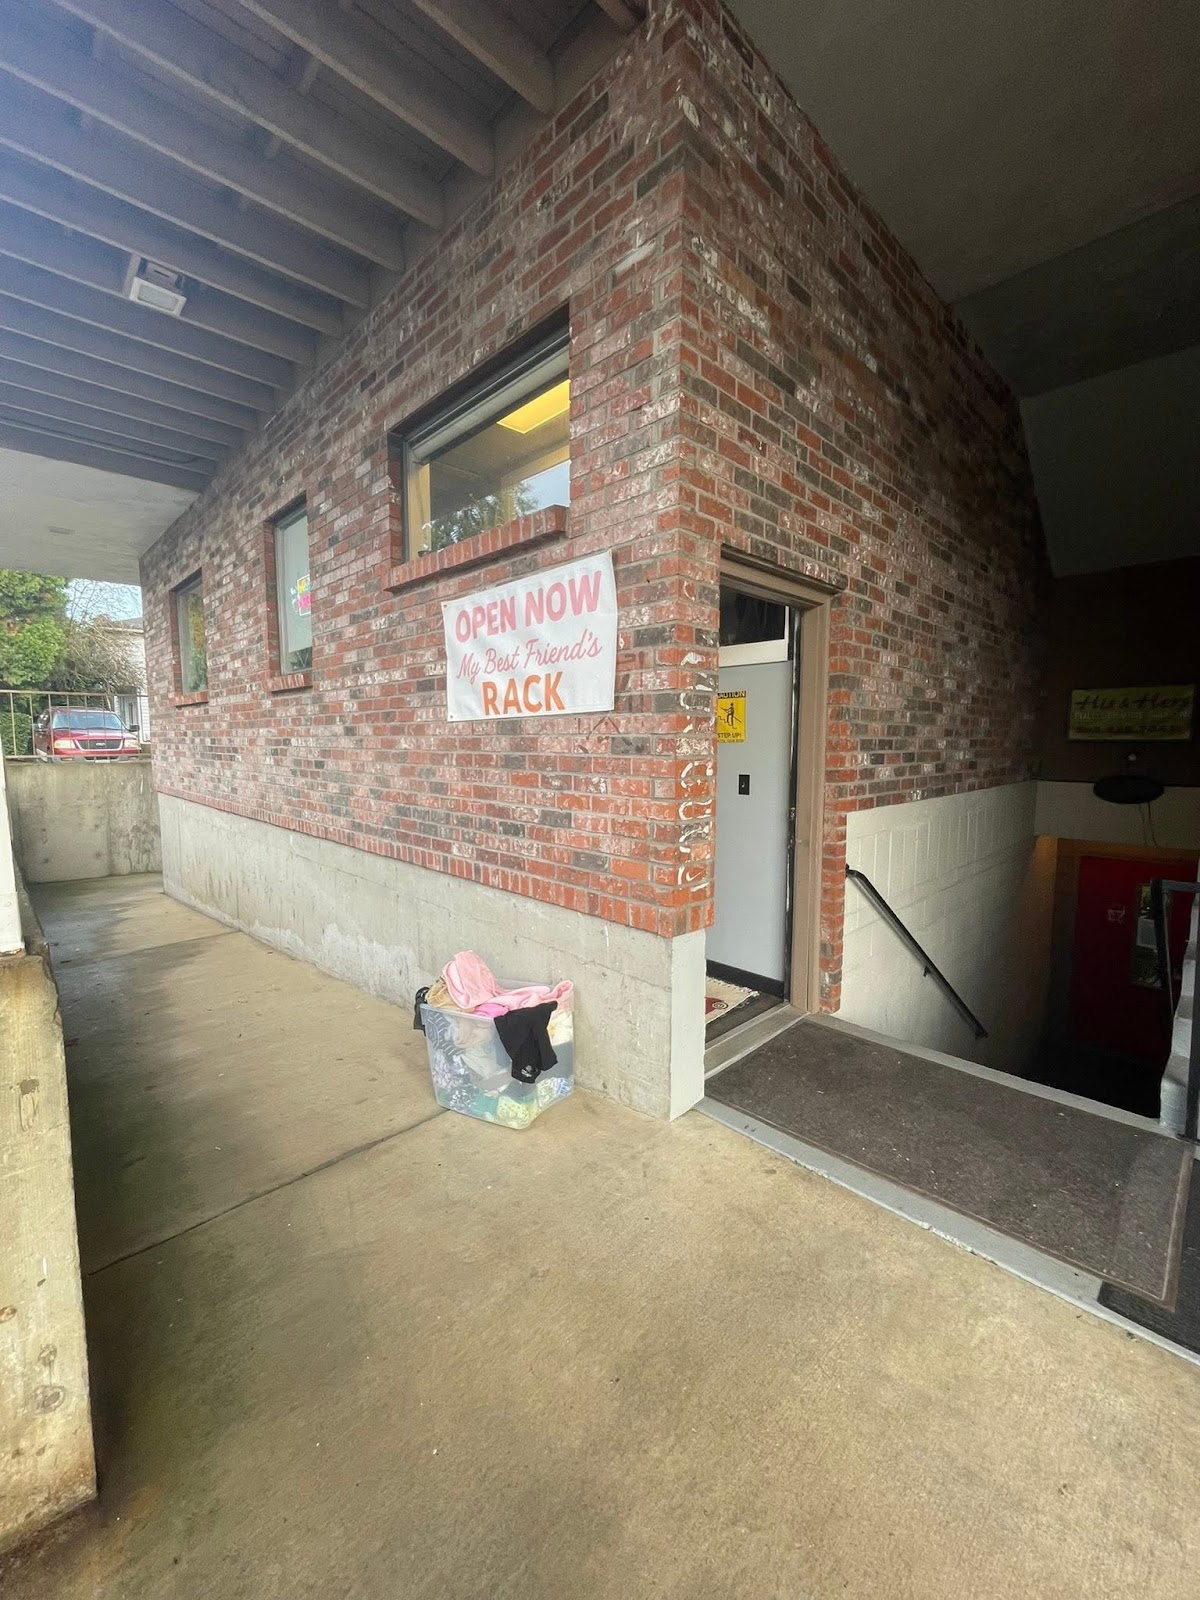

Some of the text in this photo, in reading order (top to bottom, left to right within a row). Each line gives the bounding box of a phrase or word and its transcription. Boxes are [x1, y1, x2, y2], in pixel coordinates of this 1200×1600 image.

[455, 571, 602, 643] OPEN NOW
[457, 628, 603, 685] My Best Friend's
[482, 671, 565, 716] RACK
[718, 690, 746, 698] AUTION
